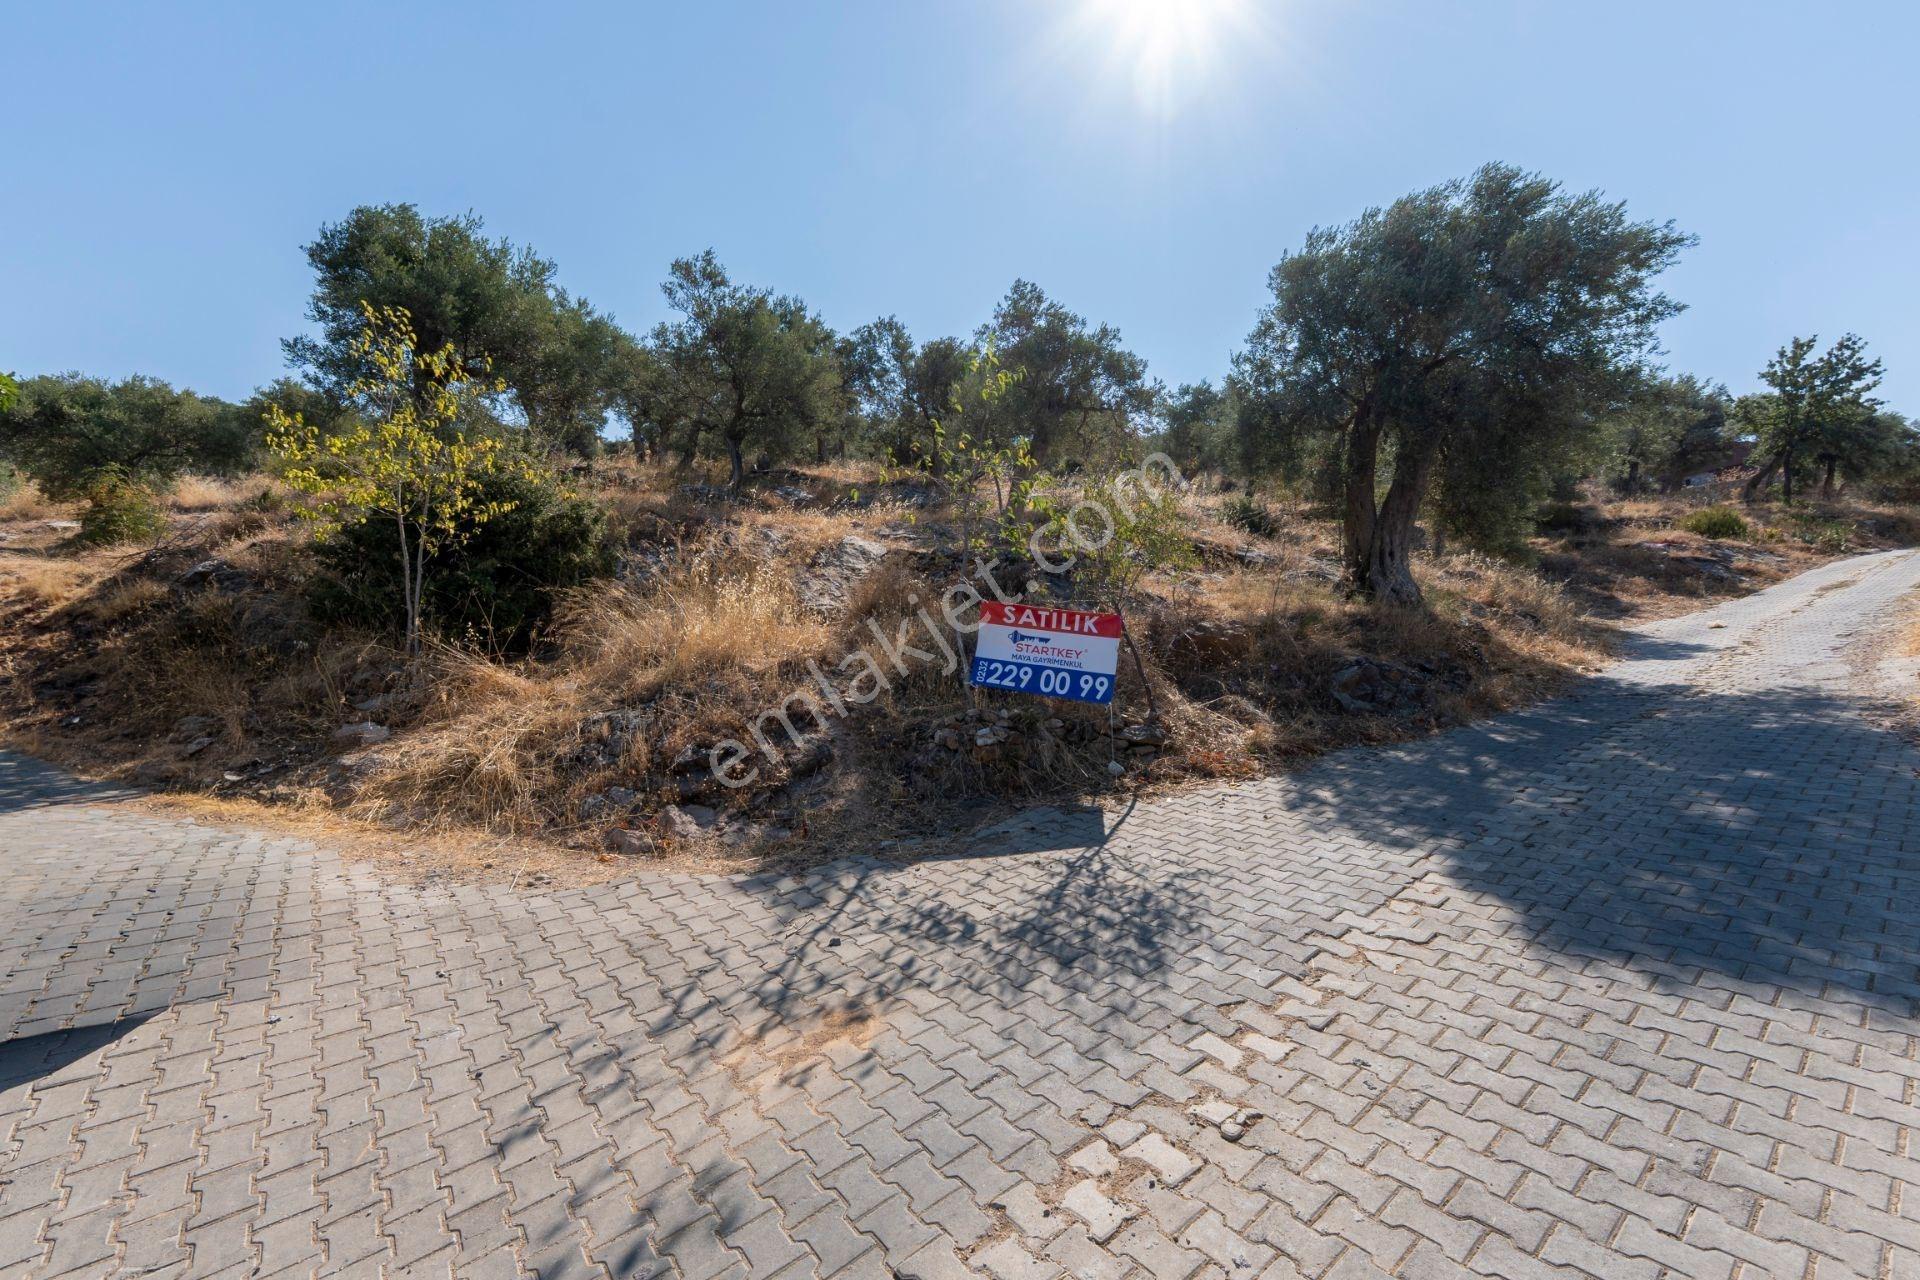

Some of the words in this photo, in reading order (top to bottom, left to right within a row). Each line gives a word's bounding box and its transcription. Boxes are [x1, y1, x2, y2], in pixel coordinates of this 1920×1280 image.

[1003, 605, 1099, 634] SATILIK
[1011, 653, 1031, 663] MAYA
[1015, 642, 1083, 659] STARTKEY
[976, 660, 988, 682] 0232
[986, 662, 1033, 688] 229
[1039, 669, 1071, 695] 00
[1079, 674, 1109, 700] 99
